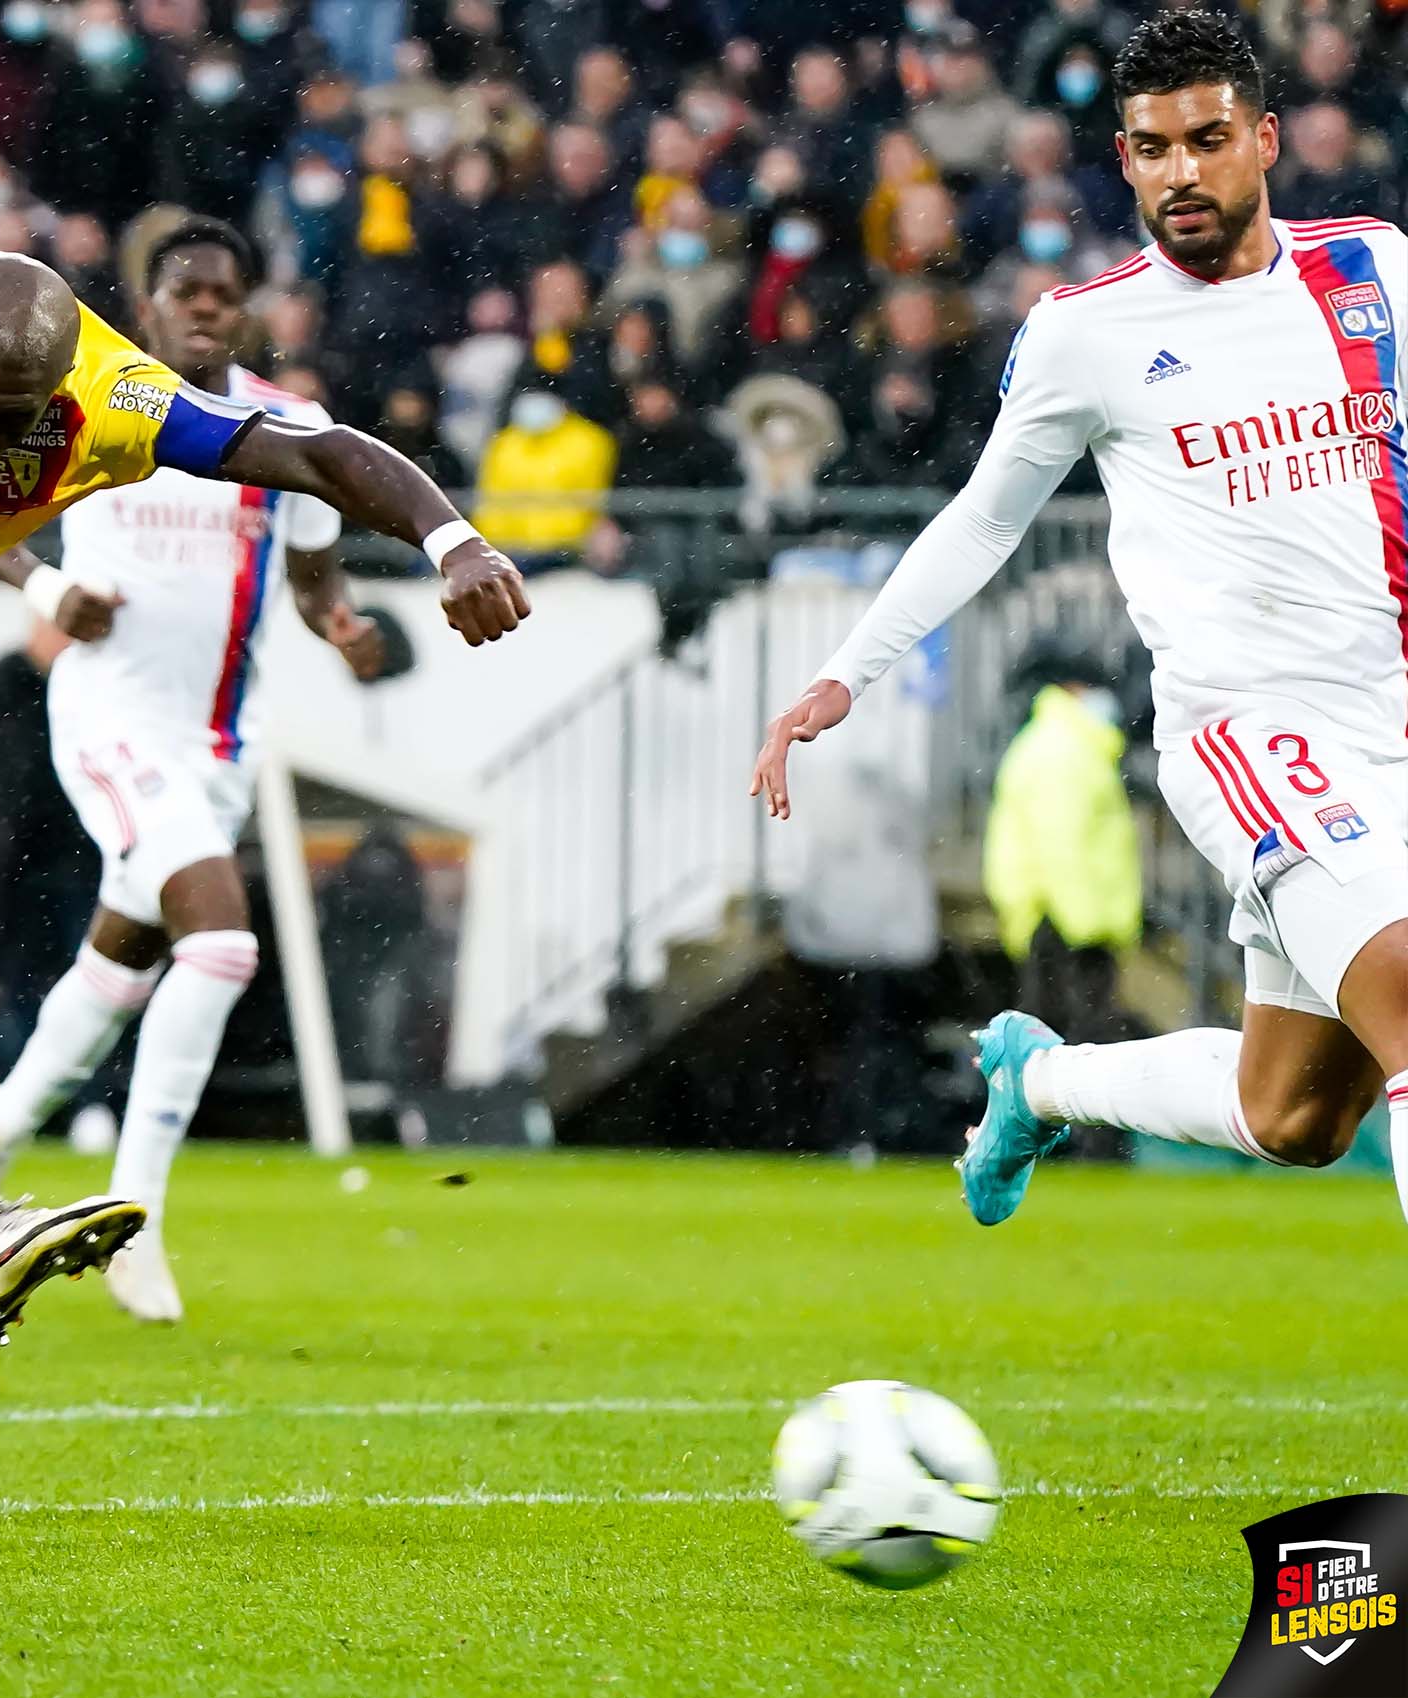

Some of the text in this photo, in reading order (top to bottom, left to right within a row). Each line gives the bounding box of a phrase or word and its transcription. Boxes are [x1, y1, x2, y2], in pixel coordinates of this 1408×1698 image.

[1144, 361, 1192, 385] adidas
[21, 434, 67, 447] HINGS
[1170, 391, 1396, 469] Emirates
[1226, 438, 1384, 507] FLY BETTER
[1267, 733, 1333, 799] 3
